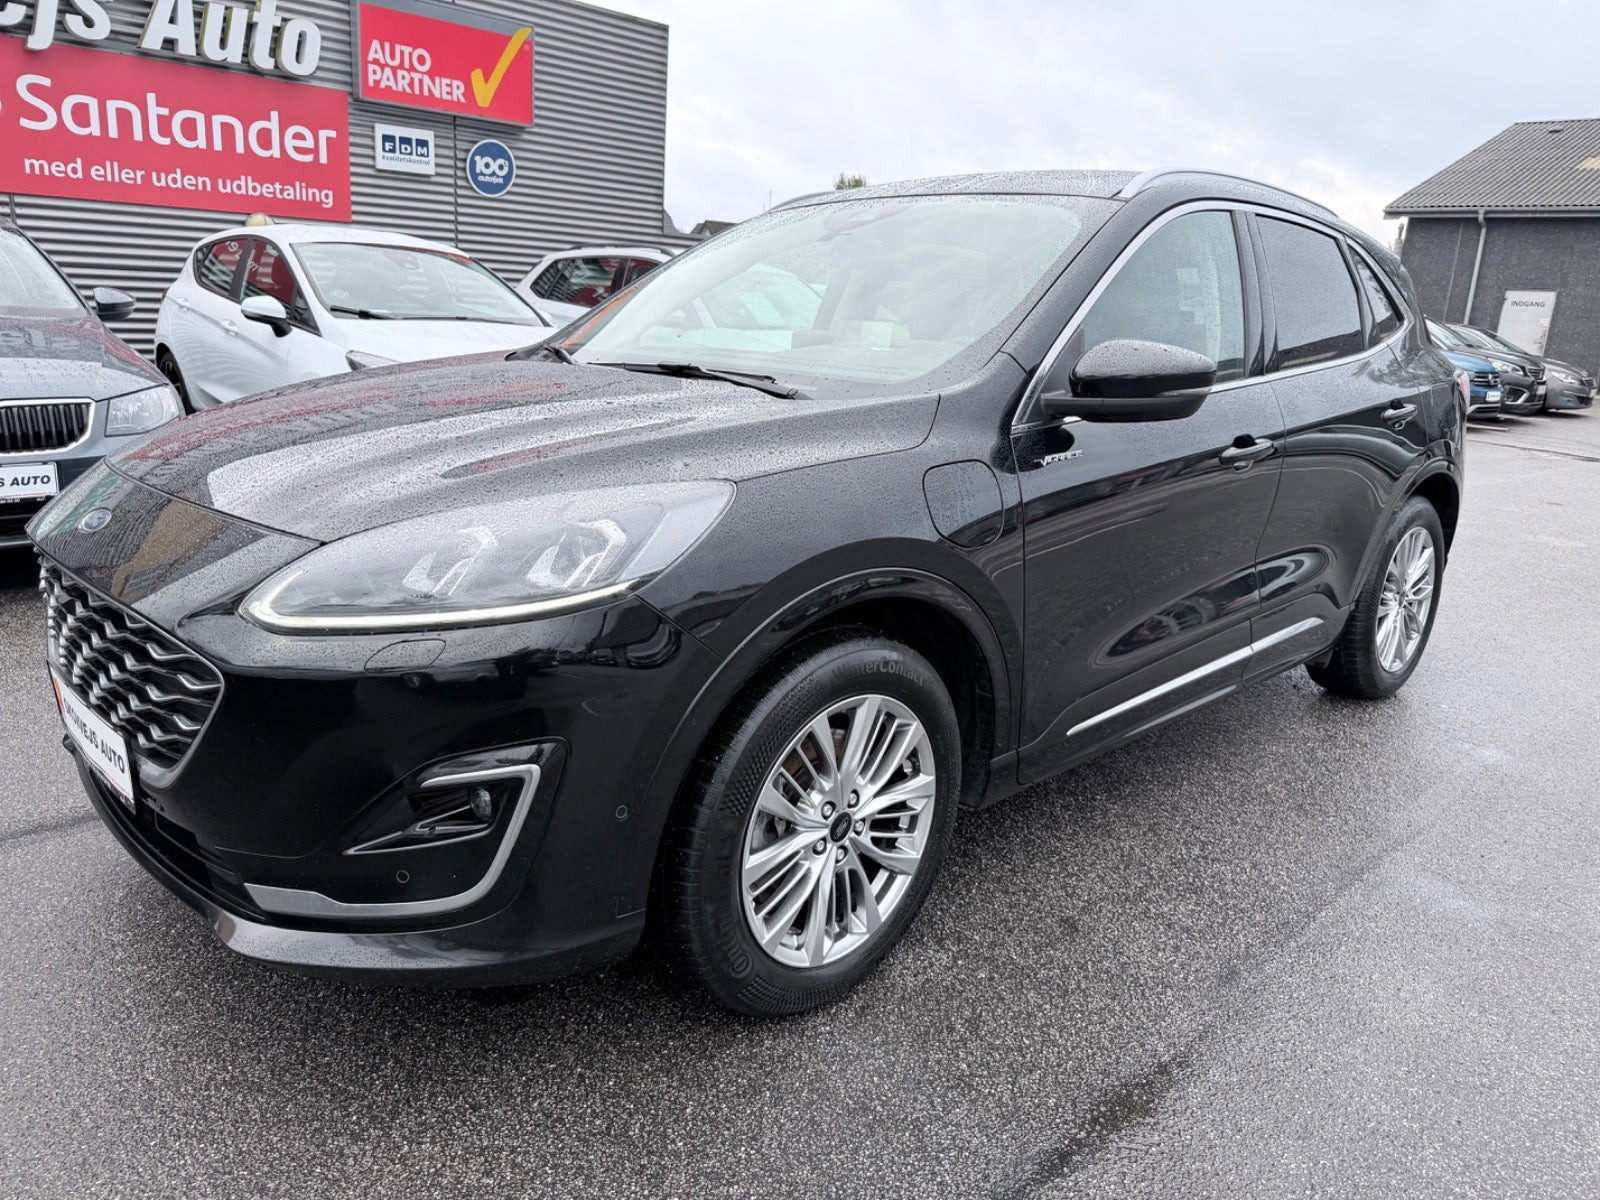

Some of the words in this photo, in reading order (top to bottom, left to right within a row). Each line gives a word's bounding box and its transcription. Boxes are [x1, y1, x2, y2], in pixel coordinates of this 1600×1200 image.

[138, 0, 322, 76] Auto
[367, 39, 431, 72] AUTO
[367, 63, 466, 103] PARTNER
[16, 74, 336, 164] Santander
[383, 139, 429, 157] FDM
[24, 158, 83, 179] med
[90, 160, 144, 185] eller
[152, 168, 211, 191] uden
[218, 175, 333, 208] udbetaling
[1511, 300, 1546, 308] INDGANG
[10, 475, 51, 487] AUTO
[102, 739, 125, 774] AUTO
